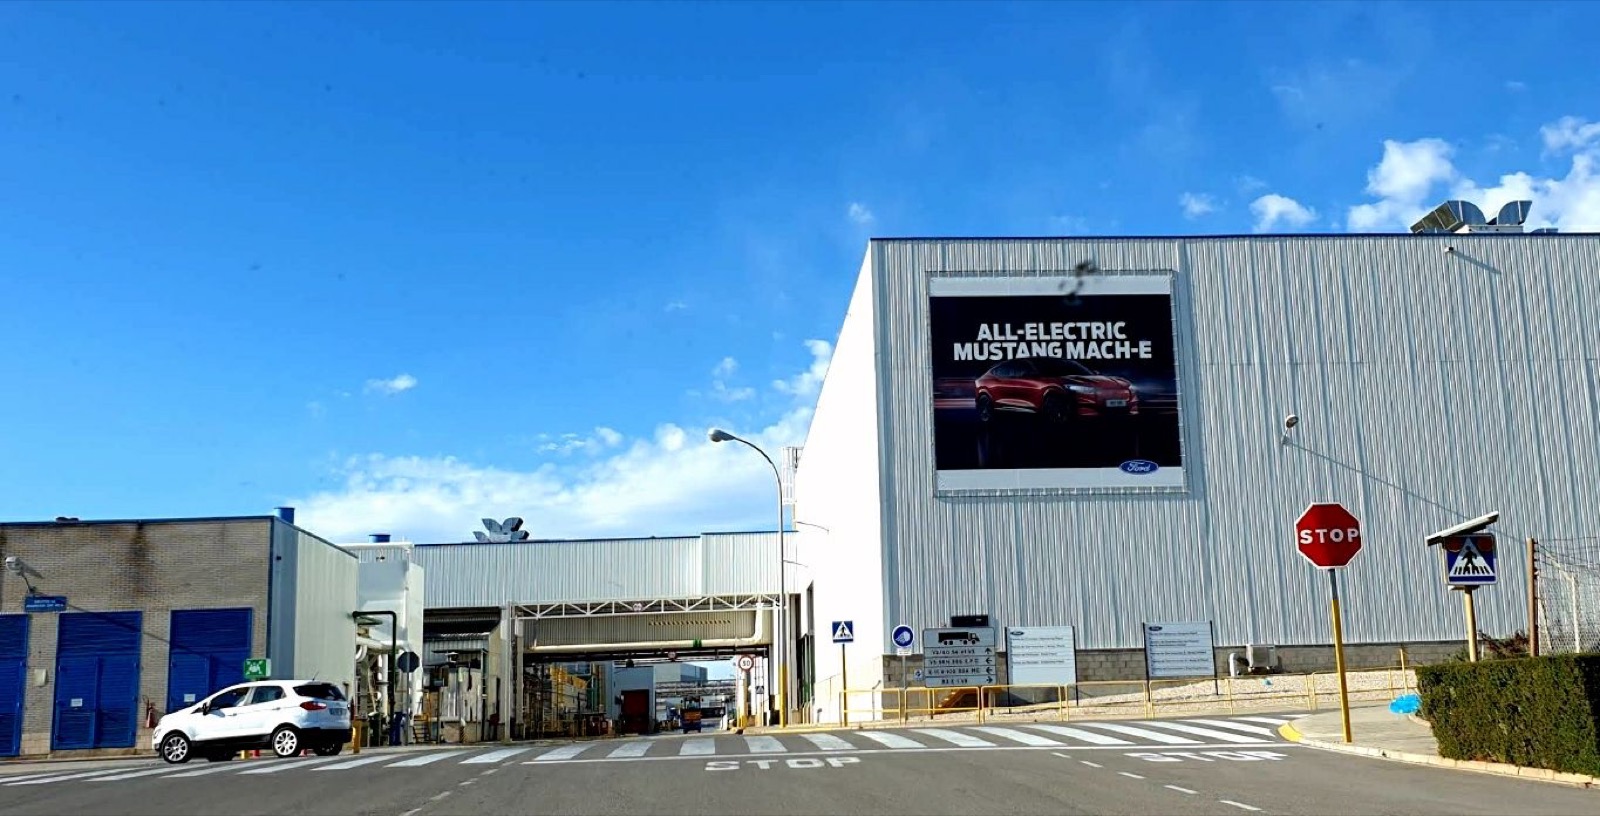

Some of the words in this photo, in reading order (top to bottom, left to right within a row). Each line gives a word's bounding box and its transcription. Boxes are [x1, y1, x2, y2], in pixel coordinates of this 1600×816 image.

[976, 321, 1127, 341] ALL-ELECTRIC
[953, 341, 1063, 361] MUSTANG
[1066, 340, 1152, 360] MACH-E
[1127, 461, 1151, 472] Ford
[1299, 527, 1359, 545] STOP
[704, 756, 862, 771] STOP
[1123, 751, 1289, 762] STOP
